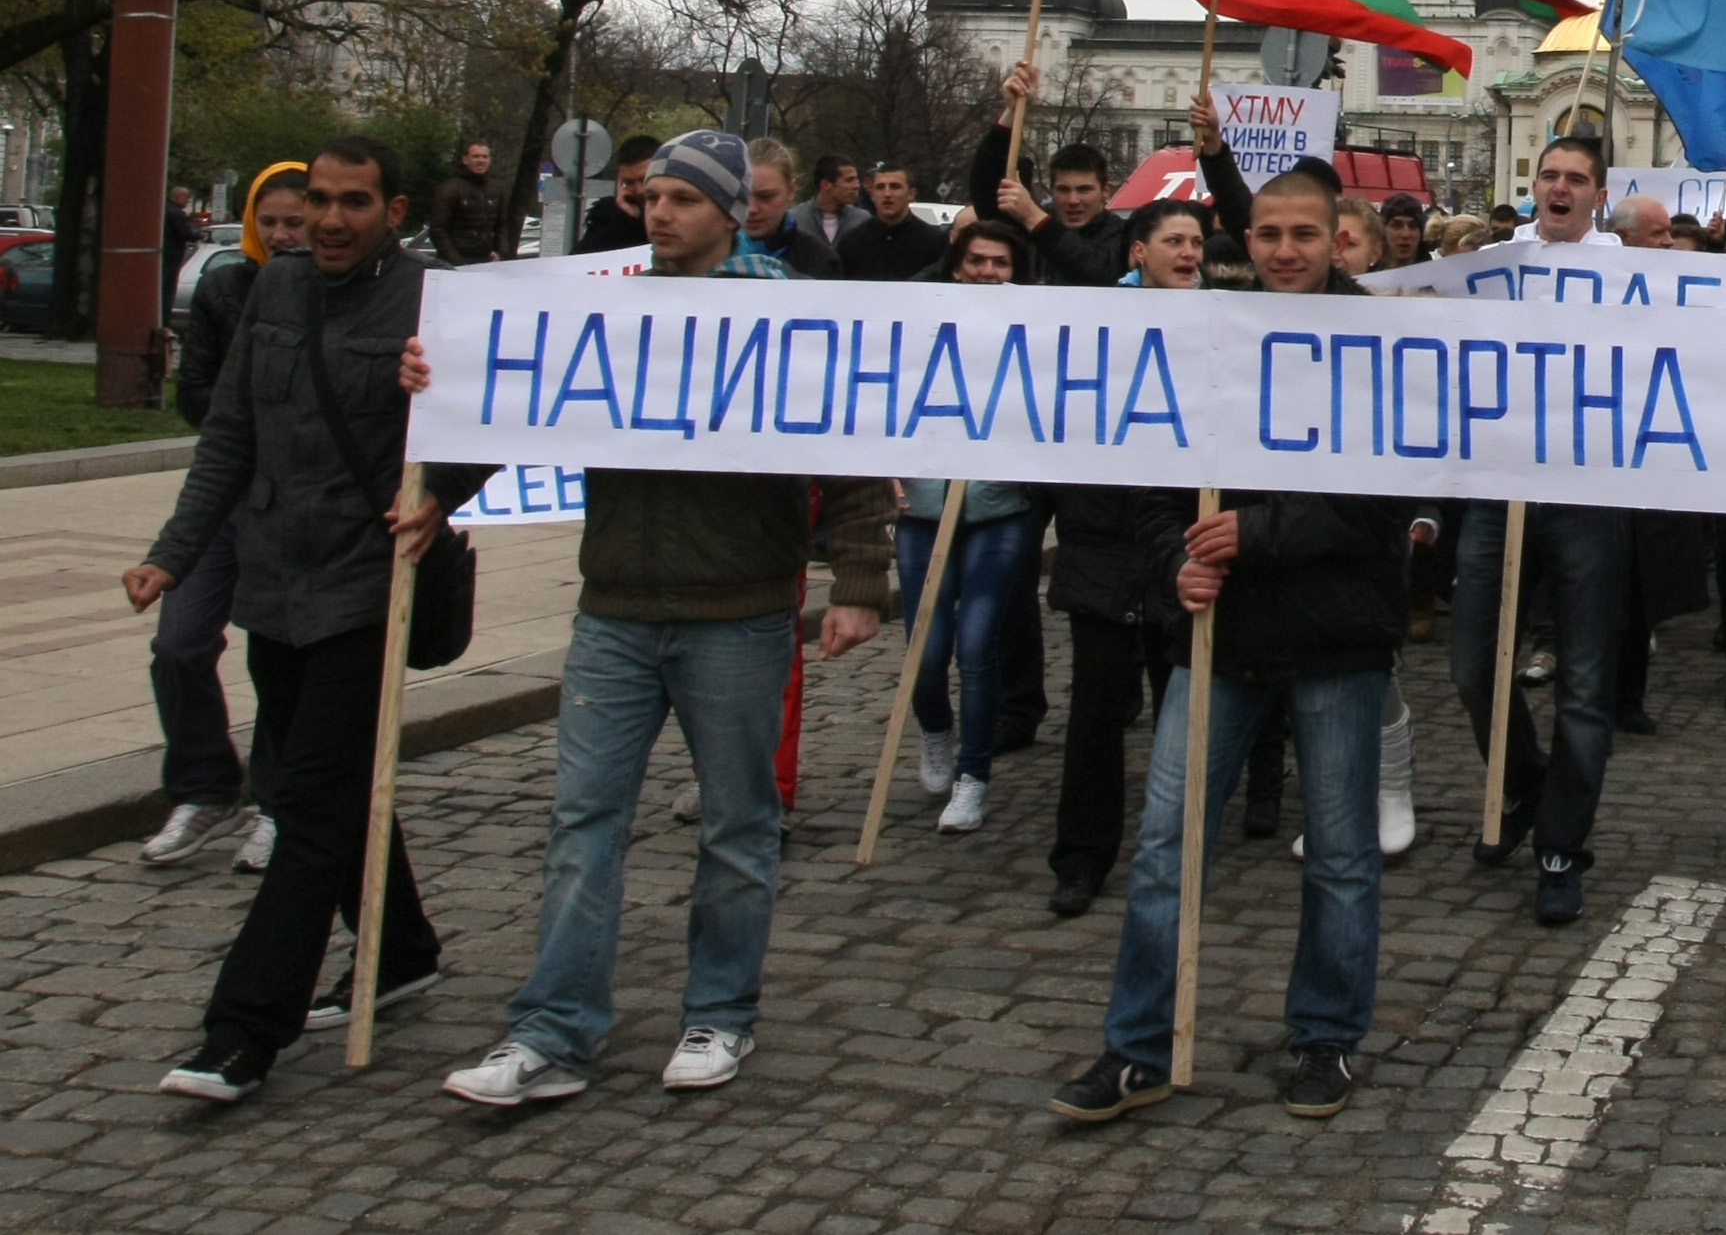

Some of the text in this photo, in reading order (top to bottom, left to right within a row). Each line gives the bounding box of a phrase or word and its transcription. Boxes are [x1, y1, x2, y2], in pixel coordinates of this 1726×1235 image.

[1225, 94, 1305, 126] ХТМУ
[1293, 130, 1307, 152] В
[480, 309, 1189, 448] НАЦИОНАЛНА
[1258, 330, 1709, 473] СПОРТНА
